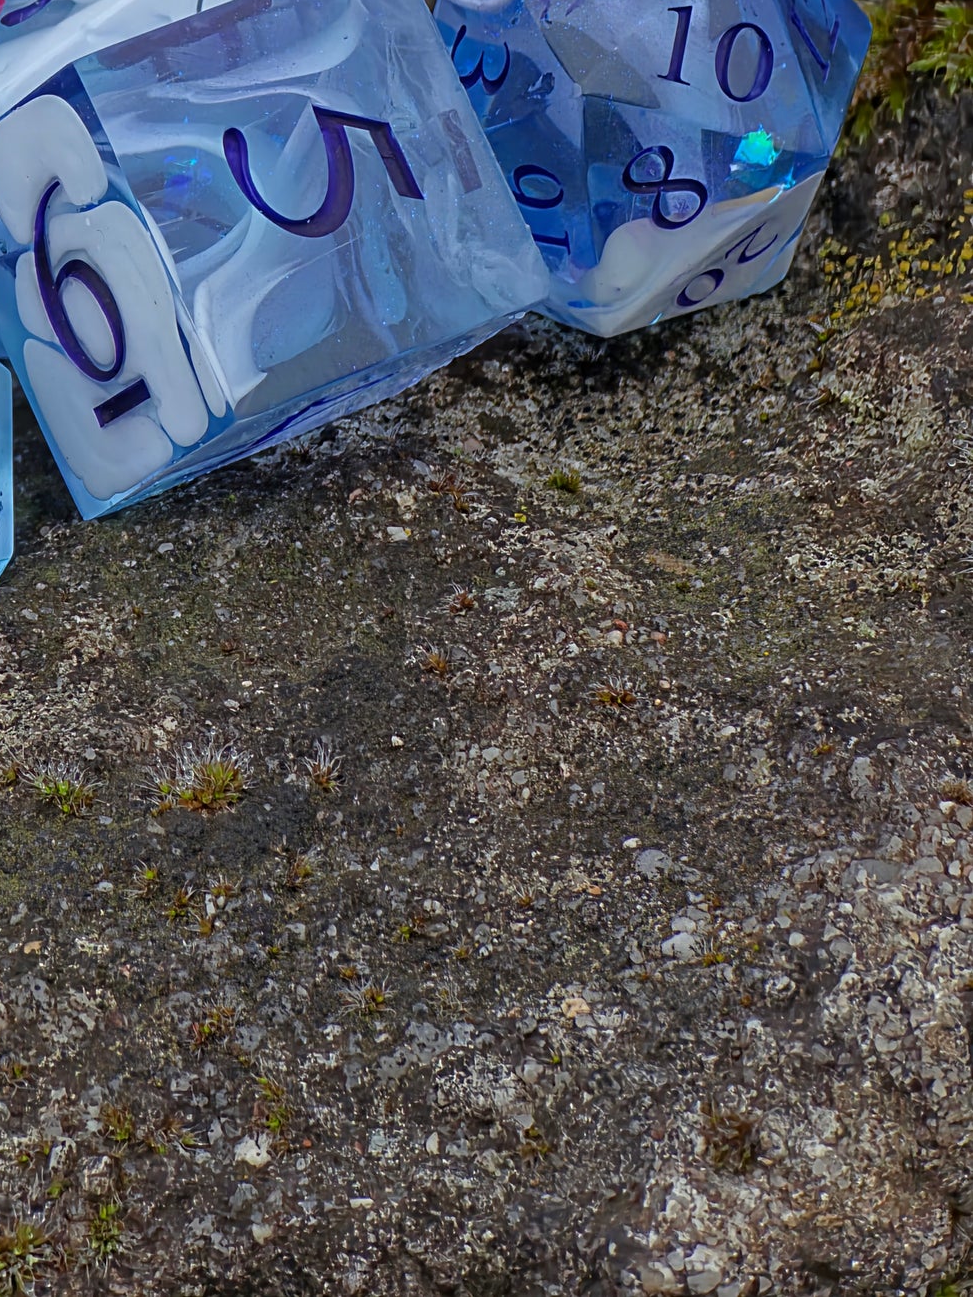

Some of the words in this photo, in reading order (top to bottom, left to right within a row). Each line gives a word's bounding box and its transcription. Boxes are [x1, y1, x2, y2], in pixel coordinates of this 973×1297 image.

[451, 24, 511, 95] 3
[657, 5, 774, 103] 10
[223, 105, 425, 238] 5
[622, 145, 708, 229] 8
[34, 181, 151, 429] 6
[676, 222, 778, 307] 20
